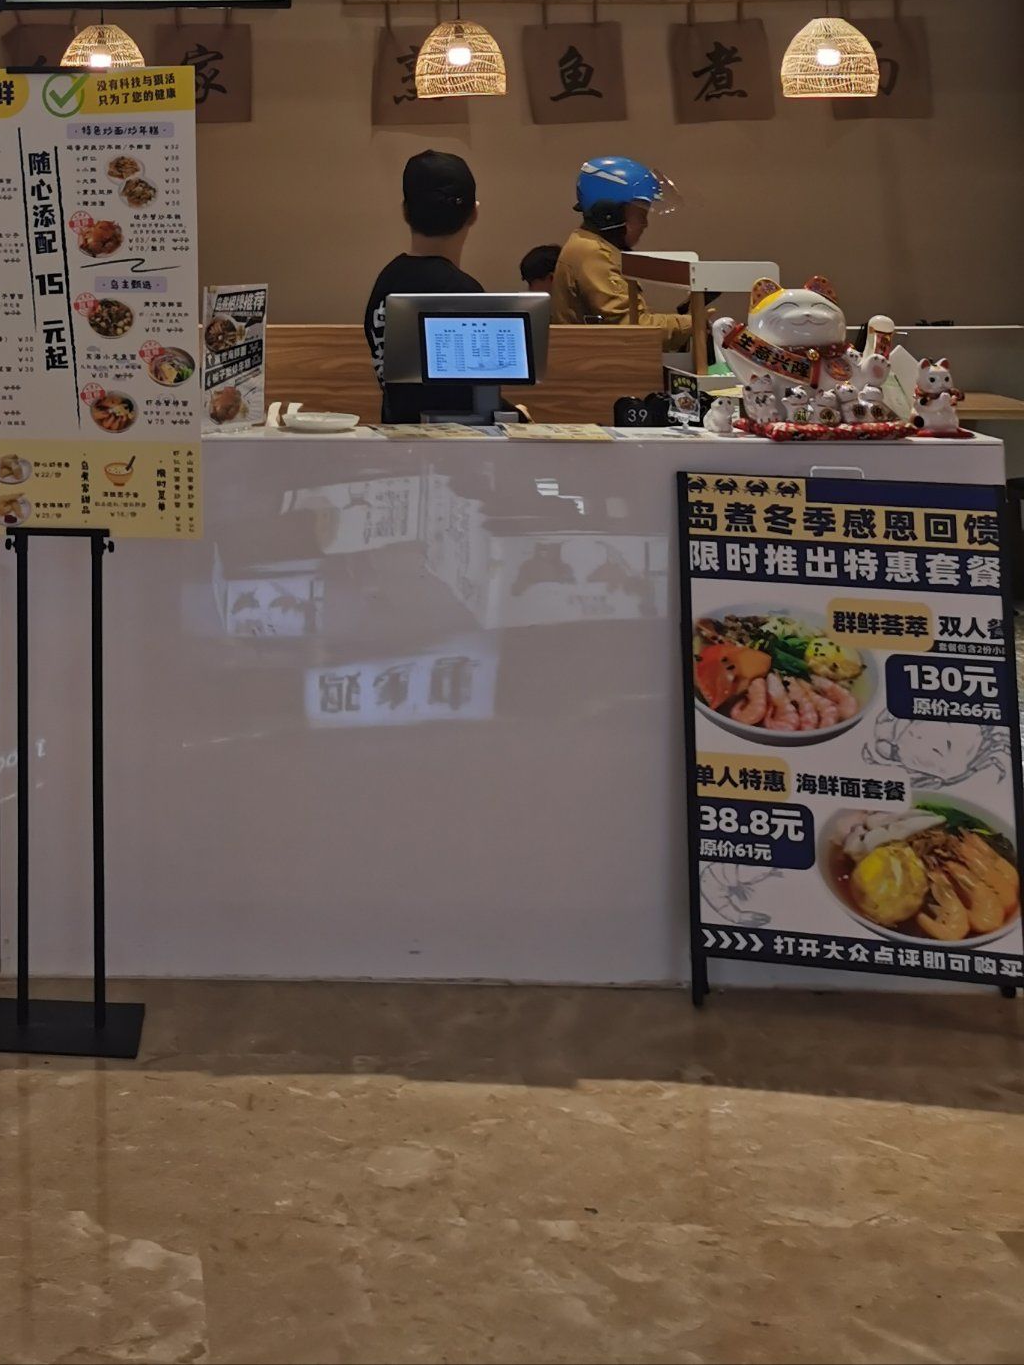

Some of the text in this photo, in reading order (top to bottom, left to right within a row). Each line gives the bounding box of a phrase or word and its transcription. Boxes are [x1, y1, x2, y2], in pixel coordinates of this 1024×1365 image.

[98, 88, 177, 106] 只为了您的健康
[627, 408, 648, 423] 39
[687, 500, 1000, 547] 岛煮冬季感恩回馈
[689, 540, 1001, 589] 限时推出特惠套餐
[833, 610, 929, 638] 群鲜荟萃
[939, 642, 1005, 656] 套餐包含2份小
[903, 664, 999, 698] 130元
[912, 697, 1001, 721] 原价266元
[696, 764, 906, 802] 单人特惠 海鲜面套餐
[699, 805, 805, 842] 38.8元
[699, 838, 773, 862] 原价61元
[773, 934, 1024, 978] 打开大众点评即可购买
